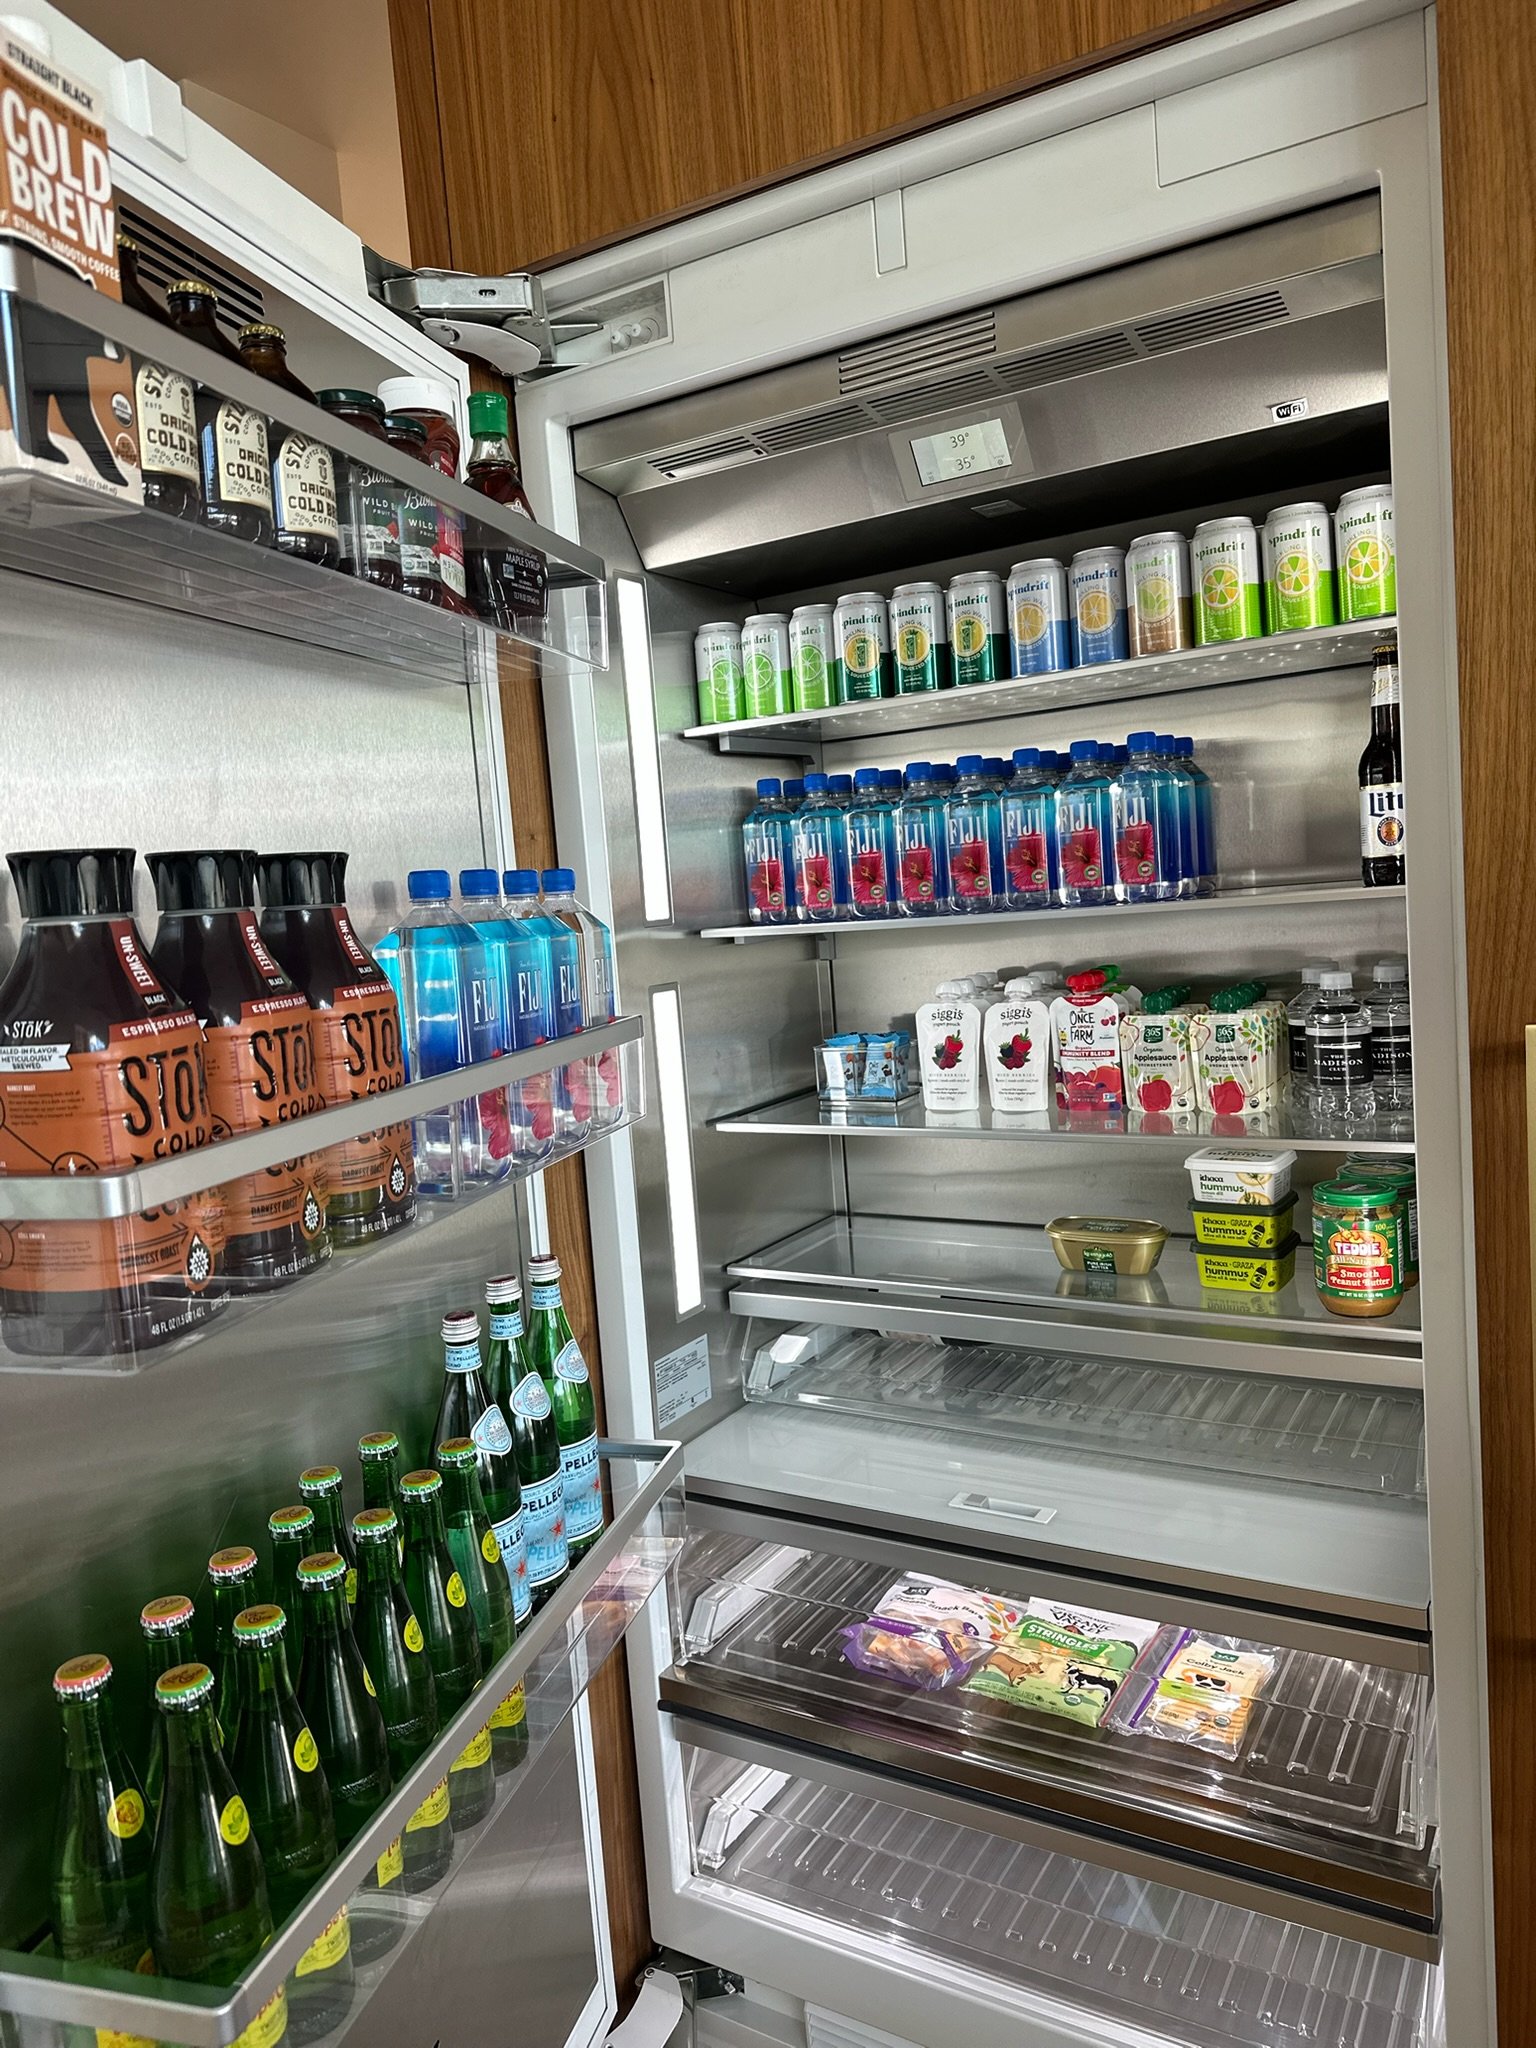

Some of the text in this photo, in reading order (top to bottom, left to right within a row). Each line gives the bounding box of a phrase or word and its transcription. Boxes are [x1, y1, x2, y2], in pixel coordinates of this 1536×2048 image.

[8, 42, 93, 111] STRAIGHT BLACK
[2, 88, 112, 203] COLD
[7, 149, 115, 258] BREW
[51, 236, 88, 267] SMOOTH
[88, 256, 120, 283] COFFEE
[147, 429, 187, 454] COLD
[949, 432, 969, 448] 39°
[955, 455, 975, 471] 35°
[226, 462, 262, 484] COLD
[289, 496, 324, 514] COLD
[363, 497, 388, 507] WILD
[408, 518, 433, 530] WILD
[1339, 508, 1393, 533] spindrft
[1268, 526, 1322, 548] spindrft
[1195, 541, 1246, 561] spindrit
[506, 553, 541, 571] MAPLE SYRUP
[1071, 567, 1118, 588] spindrift
[842, 614, 882, 629] pindrift
[891, 604, 932, 622] sindrift
[1059, 803, 1094, 833] FIJI
[1113, 797, 1147, 828] FIJI
[949, 816, 983, 845] FIJI
[1006, 809, 1042, 838] FIJI
[847, 828, 878, 855] FIJI
[896, 823, 926, 851] FIJI
[746, 837, 780, 862] FIJI
[794, 833, 825, 860] FIJI
[246, 926, 275, 971] UN-SWEET
[339, 920, 364, 961] UN-SWEET
[120, 935, 155, 988] UN-SWEET
[359, 965, 373, 975] BLACK
[268, 977, 283, 987] BLACK
[144, 994, 166, 1005] BLACK
[343, 986, 379, 998] ESPRESSO
[252, 998, 292, 1014] ESPRESSO
[121, 1013, 196, 1038] ESPRESSO BLEND
[1070, 1010, 1096, 1026] ONCE
[1070, 1026, 1095, 1046] FARM
[1145, 1027, 1161, 1037] 365
[1134, 1053, 1177, 1062] Applesauce
[1313, 1058, 1363, 1068] MADISON
[368, 1072, 401, 1097] COLD
[278, 1093, 314, 1121] COLD
[154, 1126, 206, 1159] COLD
[370, 1162, 385, 1175] ROAST
[1200, 1174, 1224, 1183] ithaca
[1200, 1181, 1245, 1192] hummus
[251, 1197, 298, 1218] DARKEST ROAST
[361, 1220, 381, 1233] 48 FL OZ
[1202, 1217, 1253, 1227] ithaca GRAZA
[1203, 1225, 1247, 1235] hummus
[1375, 1223, 1387, 1231] 100
[160, 1243, 180, 1261] ROAST
[1335, 1242, 1380, 1256] TEDDIE
[274, 1266, 282, 1277] 48
[282, 1264, 288, 1275] FL
[288, 1262, 295, 1273] OZ
[1204, 1258, 1255, 1269] ithaca GRAZA
[1205, 1266, 1249, 1277] hummus
[1330, 1275, 1390, 1287] Peanut Butter
[1340, 1269, 1380, 1278] Smooth
[151, 1323, 161, 1336] 48
[160, 1321, 168, 1334] FL
[168, 1318, 176, 1329] OZ
[1028, 1623, 1100, 1651] STRINGLES
[1186, 1658, 1245, 1676] Colby Jack
